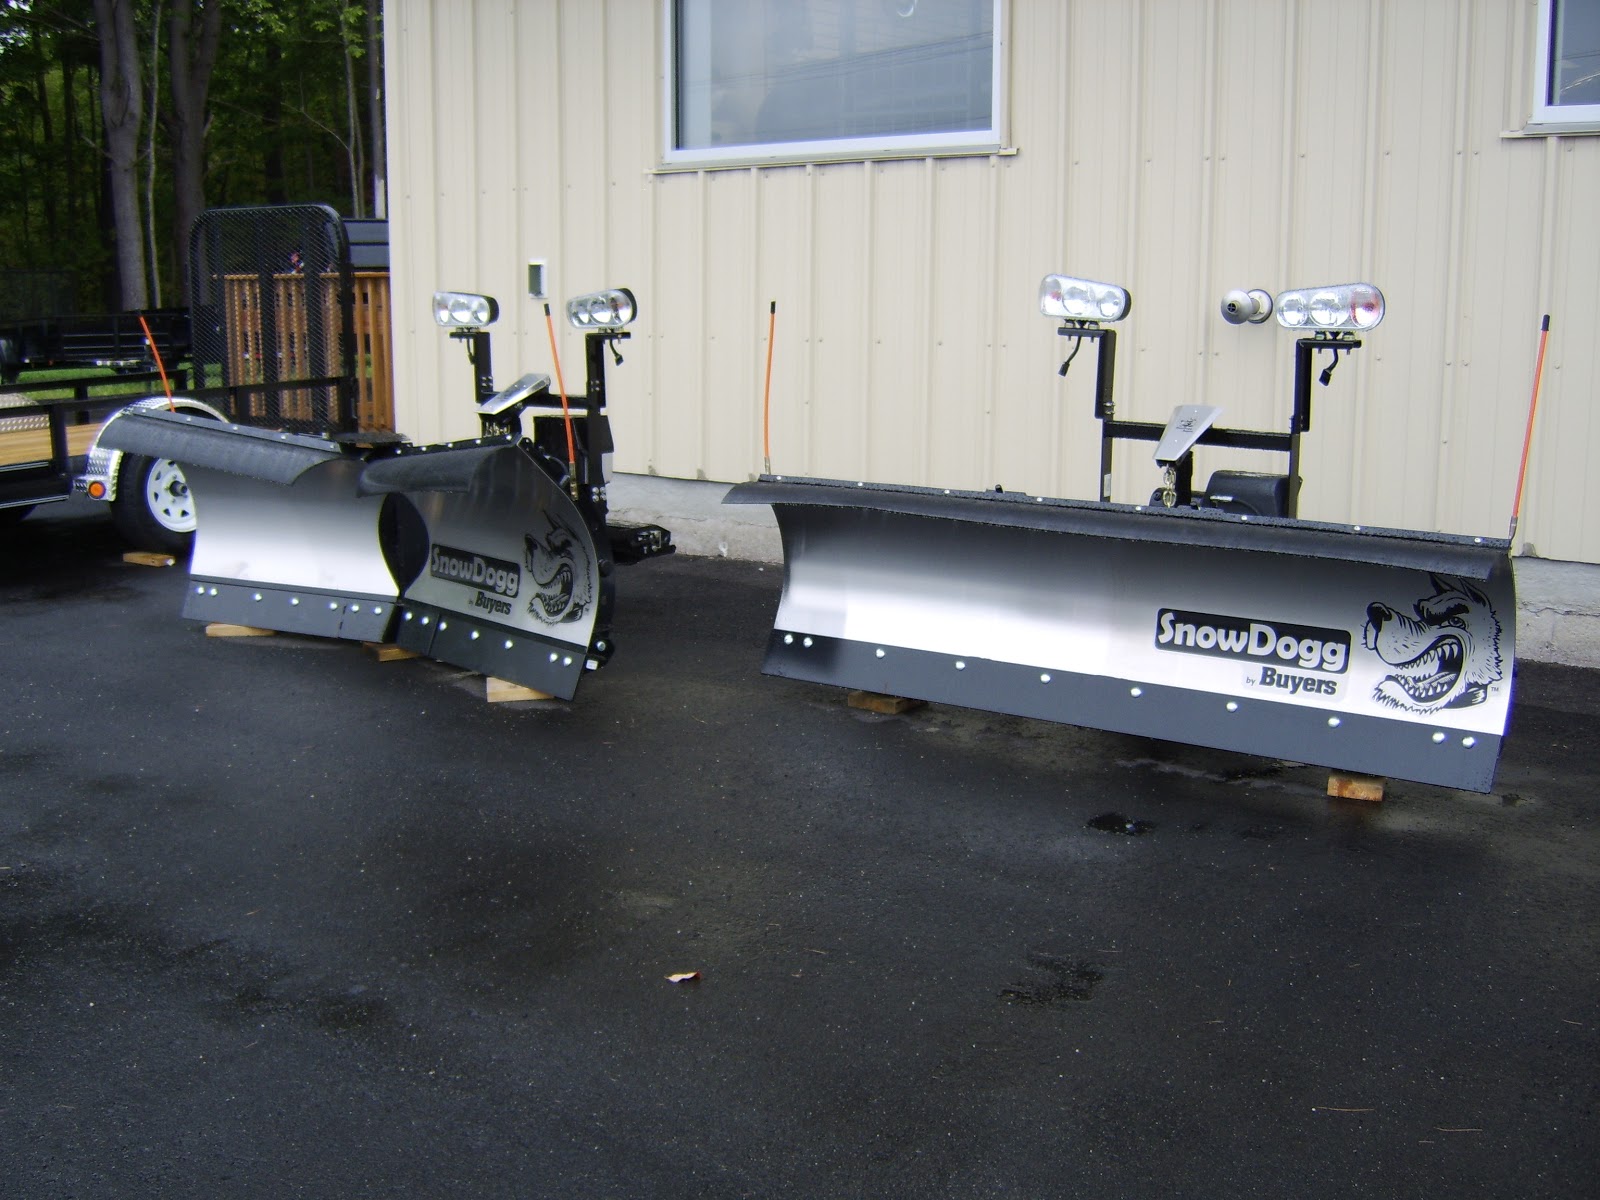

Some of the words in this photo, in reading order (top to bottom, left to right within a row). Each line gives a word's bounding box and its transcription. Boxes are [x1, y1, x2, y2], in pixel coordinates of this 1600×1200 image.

[432, 547, 519, 596] SnowDogg
[475, 591, 512, 615] Buyers
[1158, 612, 1346, 672] SnowDogg
[1246, 676, 1256, 686] by
[1259, 666, 1337, 695] Buyers
